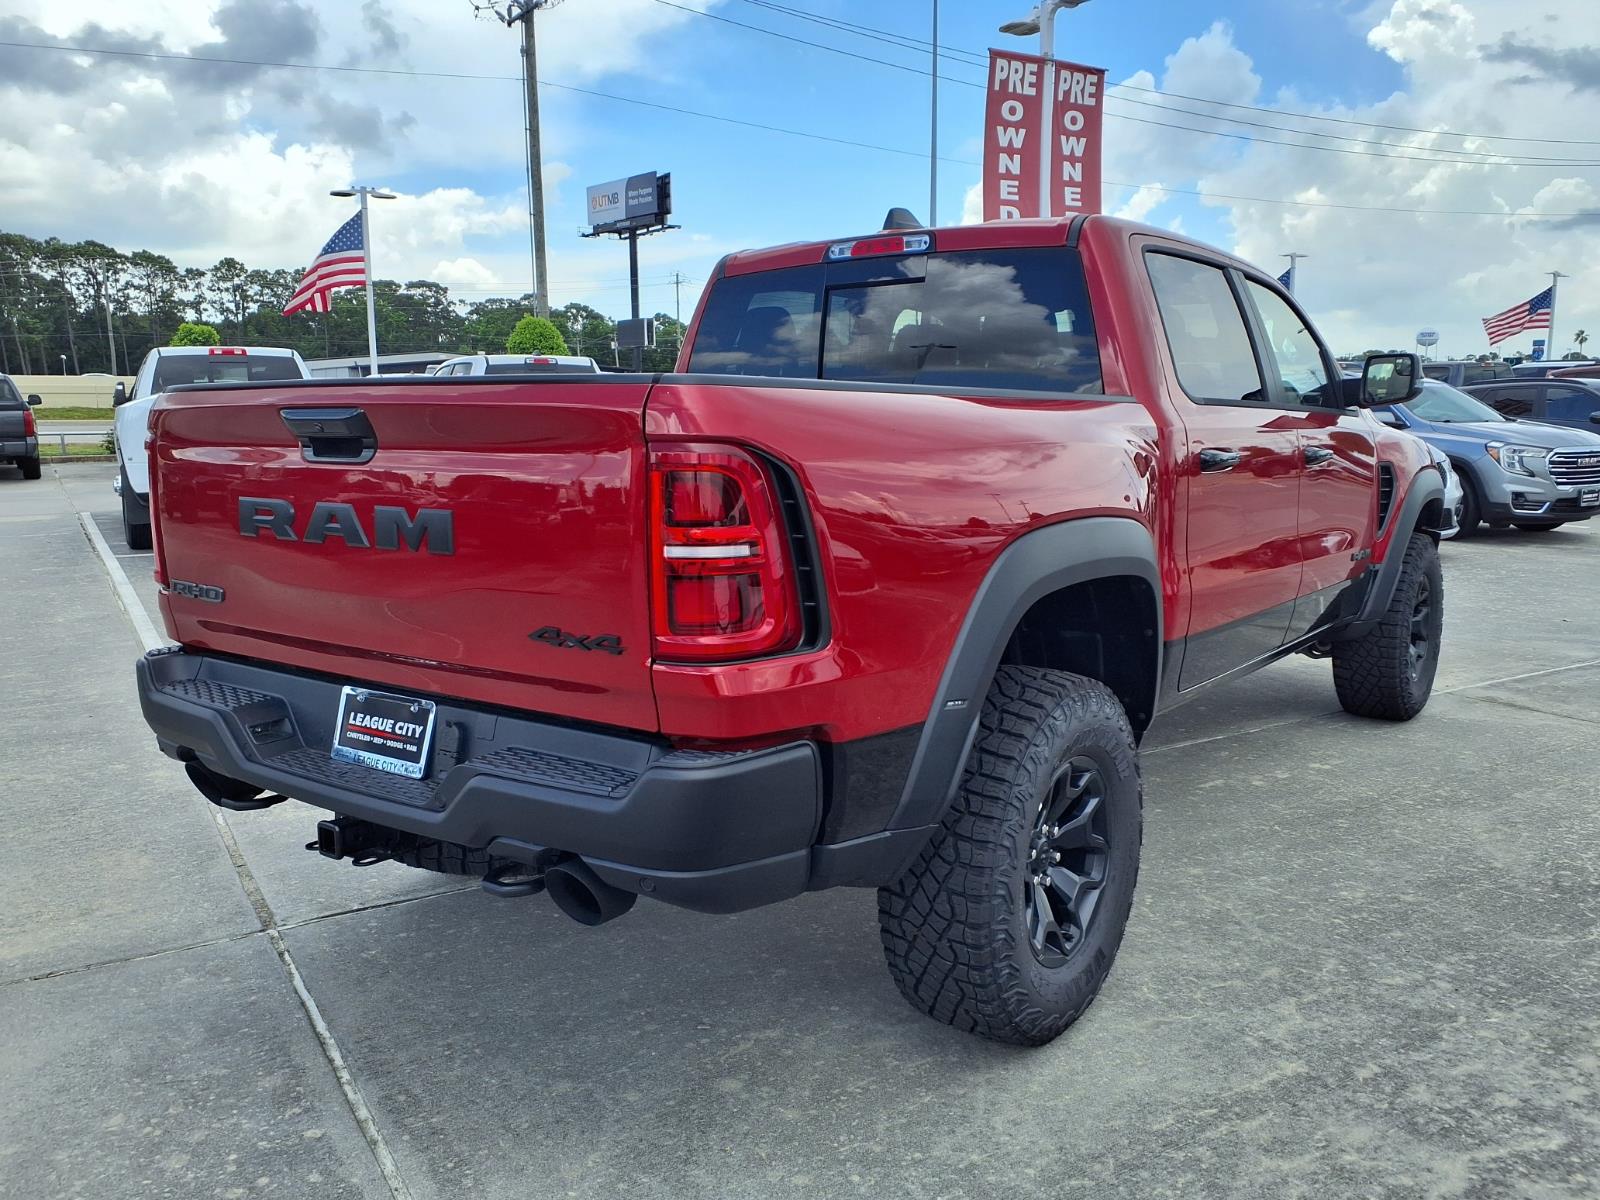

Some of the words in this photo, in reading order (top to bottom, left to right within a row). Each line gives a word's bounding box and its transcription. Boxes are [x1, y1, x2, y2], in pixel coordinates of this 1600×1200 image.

[994, 58, 1038, 96] PRE
[1058, 69, 1098, 106] PRE
[997, 99, 1027, 222] OWNED
[1060, 110, 1087, 218] OWNE
[598, 192, 619, 207] UTMB
[238, 496, 455, 556] RAM
[171, 579, 225, 603] RHO
[349, 712, 394, 732] LEAGUE
[395, 722, 423, 738] CITY
[347, 732, 370, 741] CHRYSLER
[387, 741, 403, 749] DODGE
[406, 744, 417, 752] RAM
[353, 752, 380, 768] LEAGUE
[382, 760, 397, 771] CITY
